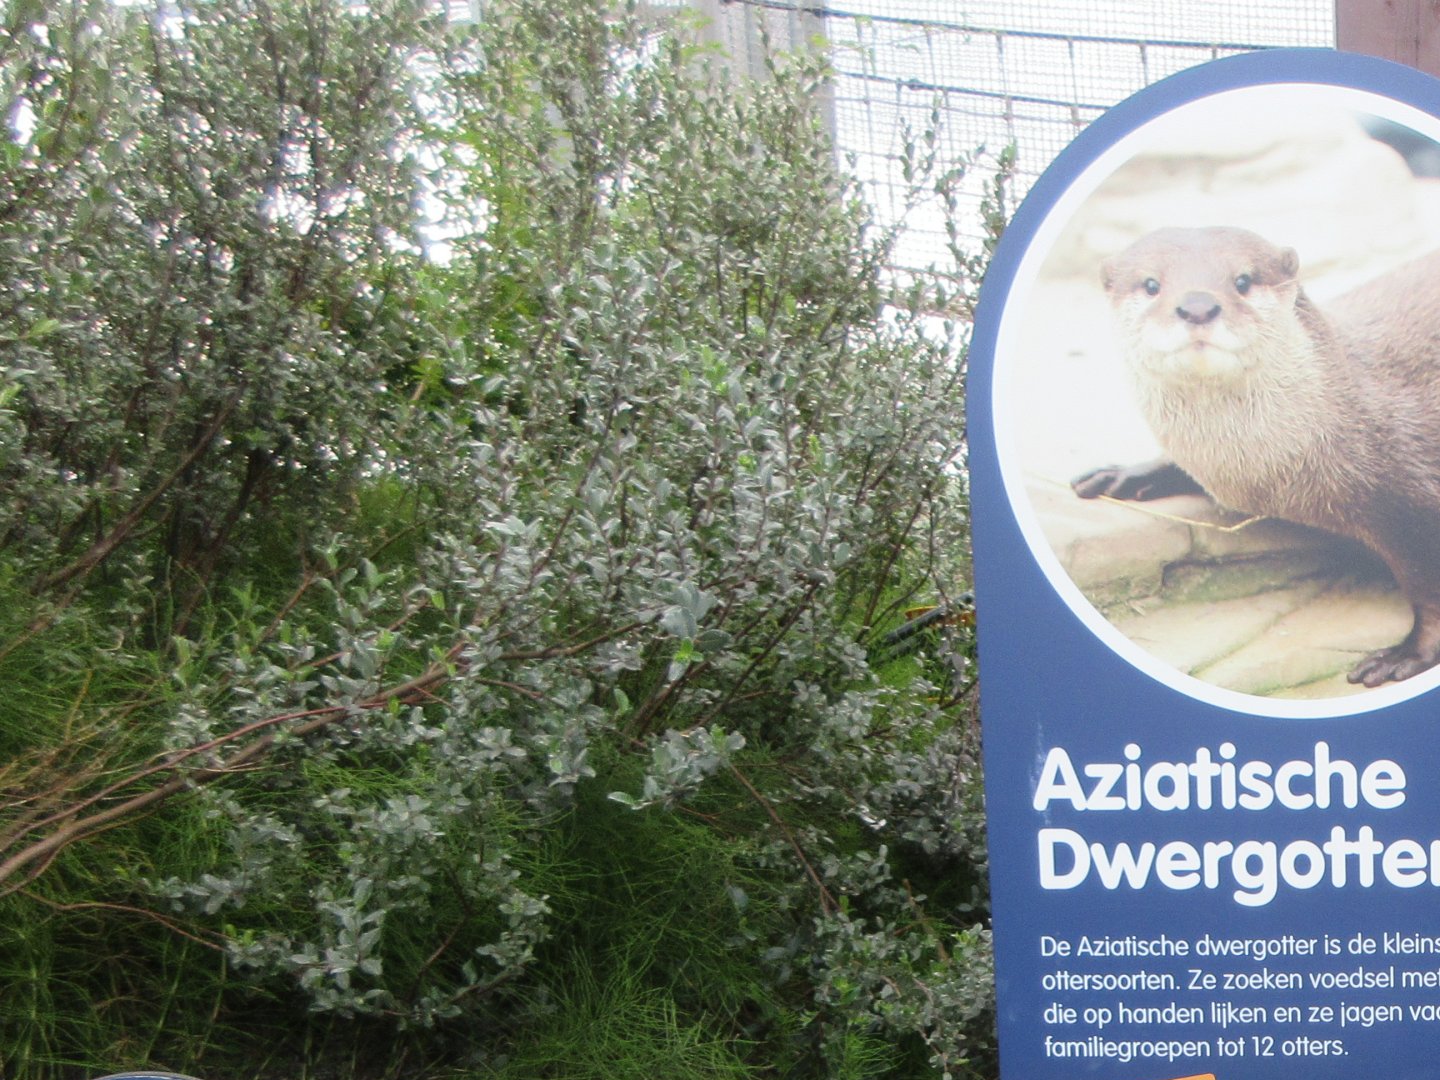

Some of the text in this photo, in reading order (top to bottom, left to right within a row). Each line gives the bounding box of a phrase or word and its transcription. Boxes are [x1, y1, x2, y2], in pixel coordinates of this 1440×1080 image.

[1032, 741, 1408, 812] Aziatische
[1040, 935, 1071, 957] De
[1076, 934, 1190, 957] Aziatische
[1195, 933, 1318, 961] dwergotter
[1324, 934, 1342, 955] is
[1347, 932, 1377, 955] de
[1042, 970, 1181, 991] ottersoorten.
[1187, 969, 1217, 990] Ze
[1222, 967, 1303, 990] zoeken
[1308, 965, 1395, 989] voedsel
[1043, 1002, 1078, 1024] die
[1083, 1007, 1112, 1030] op
[1118, 1001, 1204, 1024] handen
[1211, 1001, 1267, 1029] lijken
[1273, 1006, 1301, 1023] en
[1308, 1006, 1334, 1023] ze
[1340, 1001, 1403, 1028] jagen
[1044, 1035, 1349, 1063] familiegroepen tot 12 otters.
